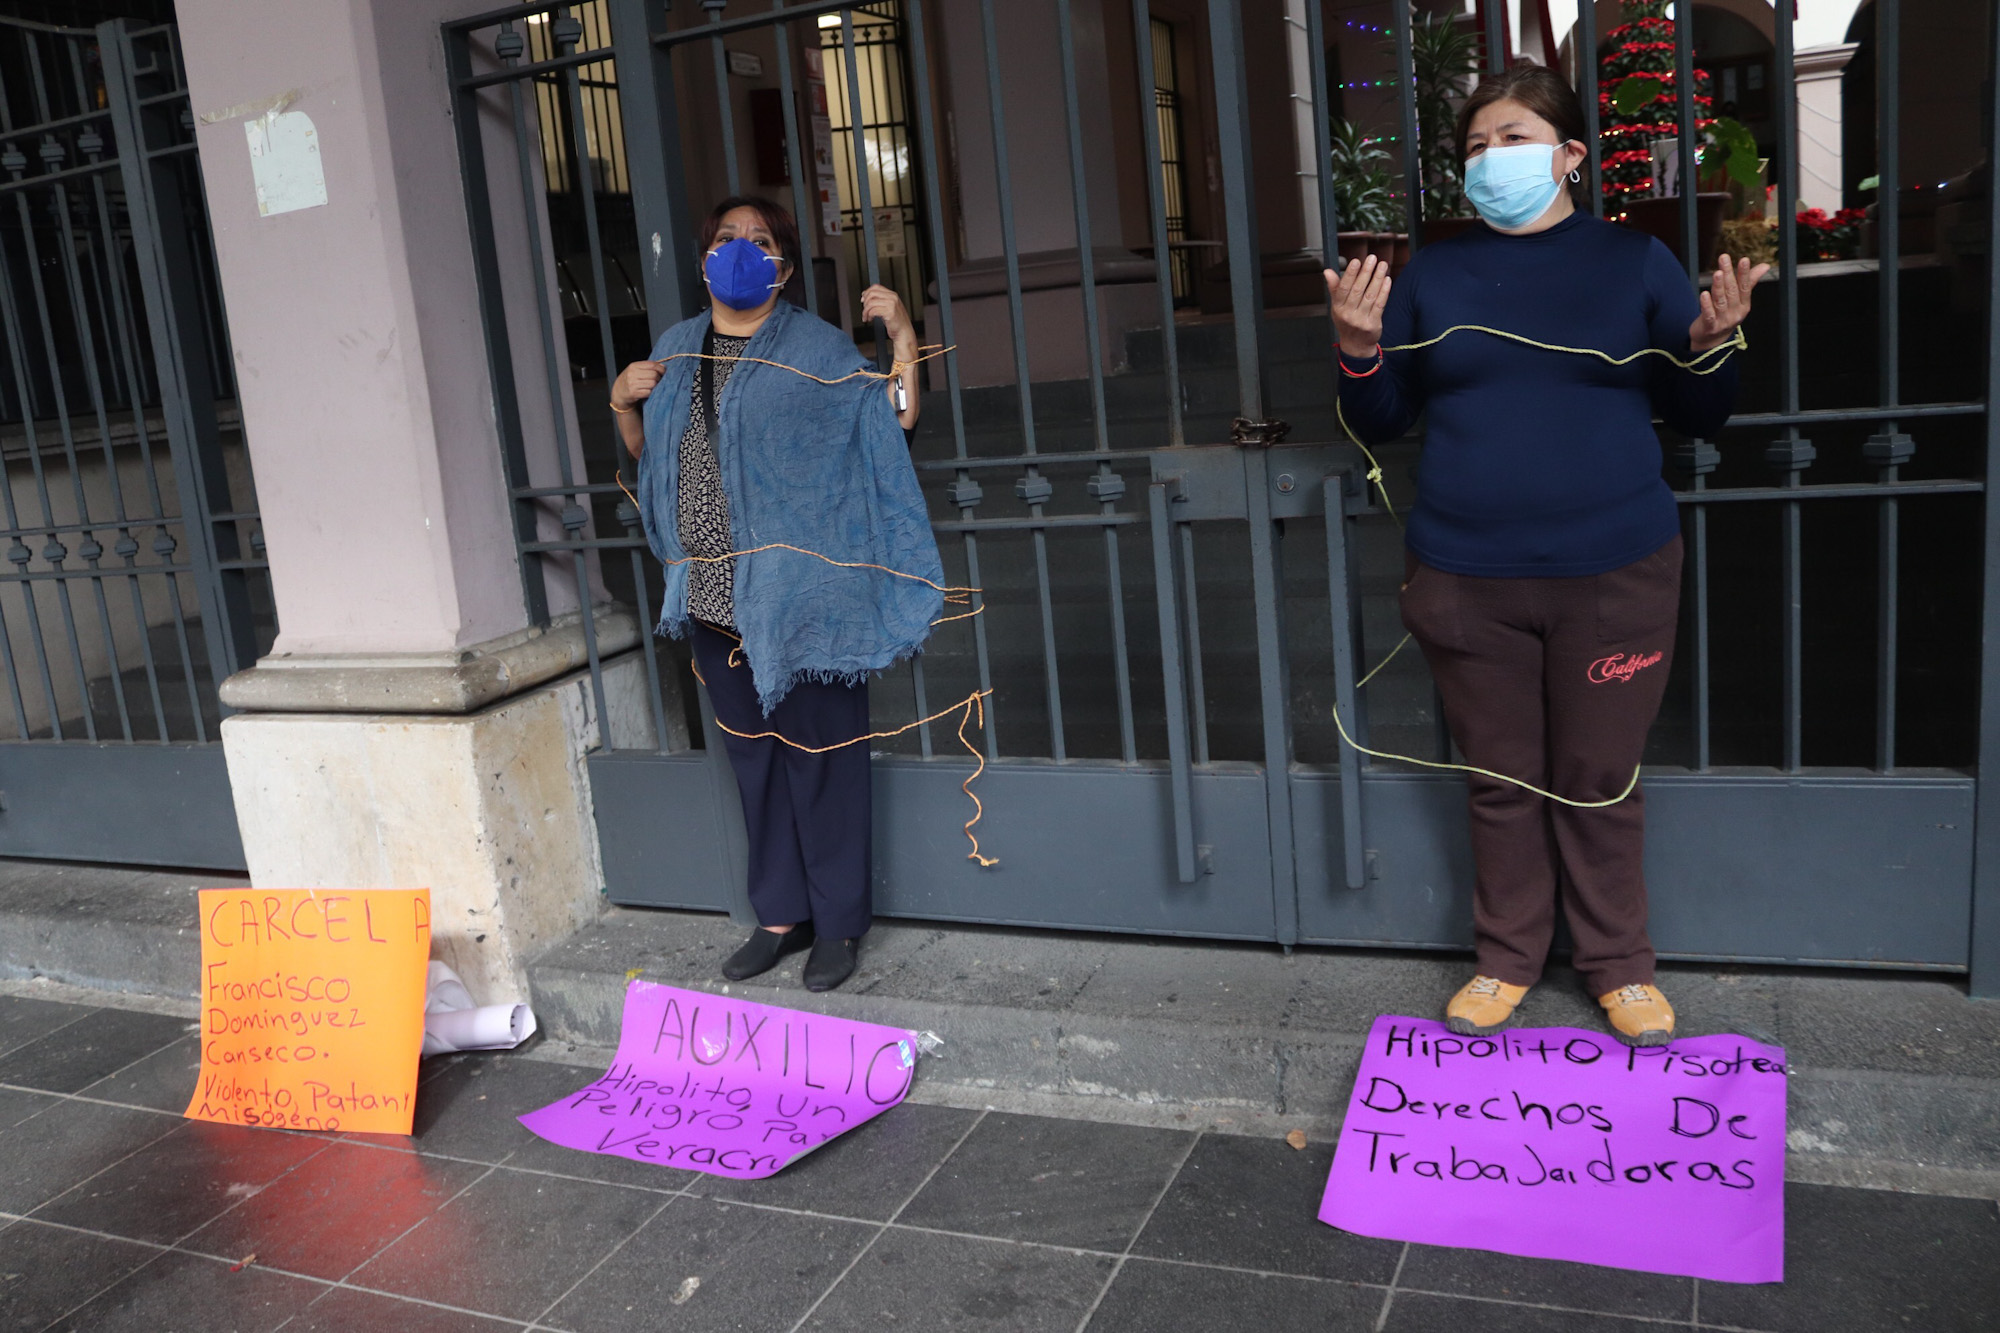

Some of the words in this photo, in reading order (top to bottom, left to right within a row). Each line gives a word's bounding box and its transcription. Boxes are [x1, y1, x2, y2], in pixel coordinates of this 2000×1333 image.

[210, 896, 387, 947] CARCEL
[208, 1007, 366, 1037] Dominguez
[653, 998, 911, 1105] AUXILIO
[1385, 1025, 1603, 1067] Hipolito
[777, 1094, 846, 1123] Un
[1359, 1076, 1613, 1132] Derechos
[1668, 1096, 1757, 1140] De
